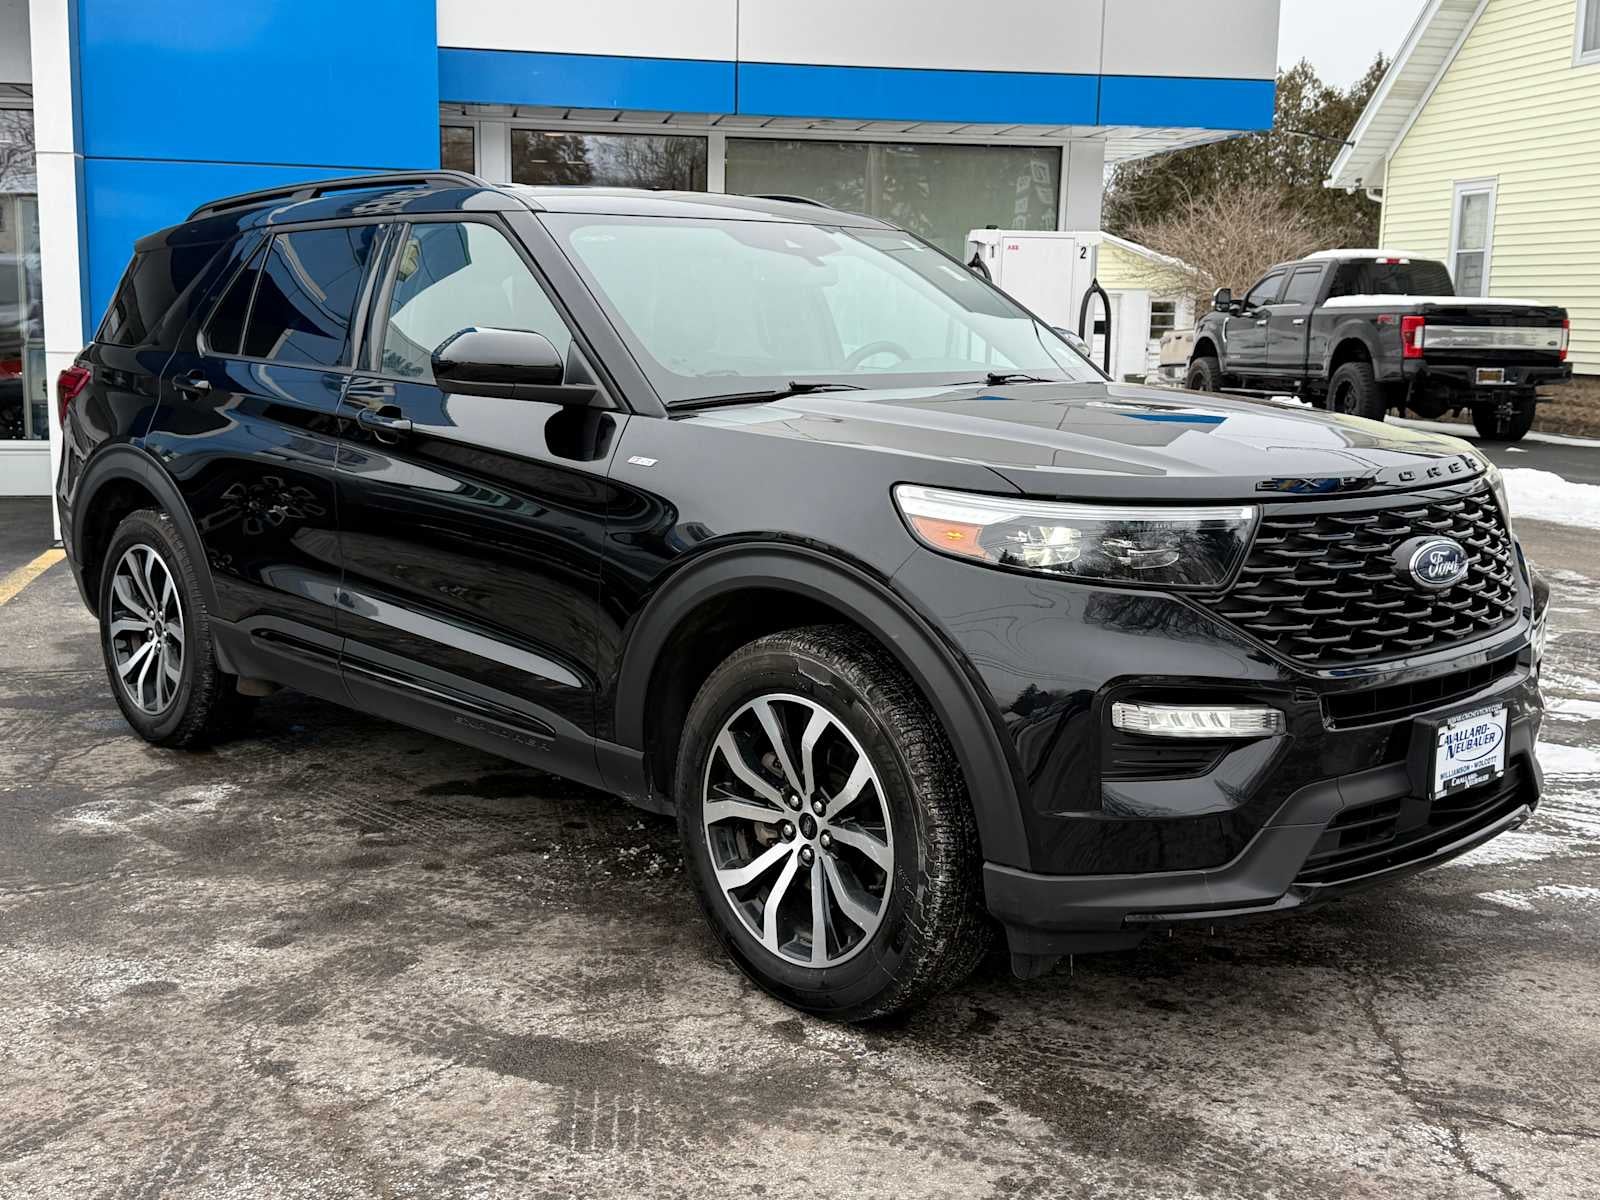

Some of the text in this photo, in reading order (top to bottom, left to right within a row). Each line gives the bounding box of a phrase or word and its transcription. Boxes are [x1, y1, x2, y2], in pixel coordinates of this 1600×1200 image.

[991, 245, 995, 258] 1
[1079, 246, 1087, 259] 2
[1428, 550, 1460, 578] Ford
[1446, 732, 1495, 760] NEUBAUER
[1440, 765, 1470, 779] WILLIAMSON
